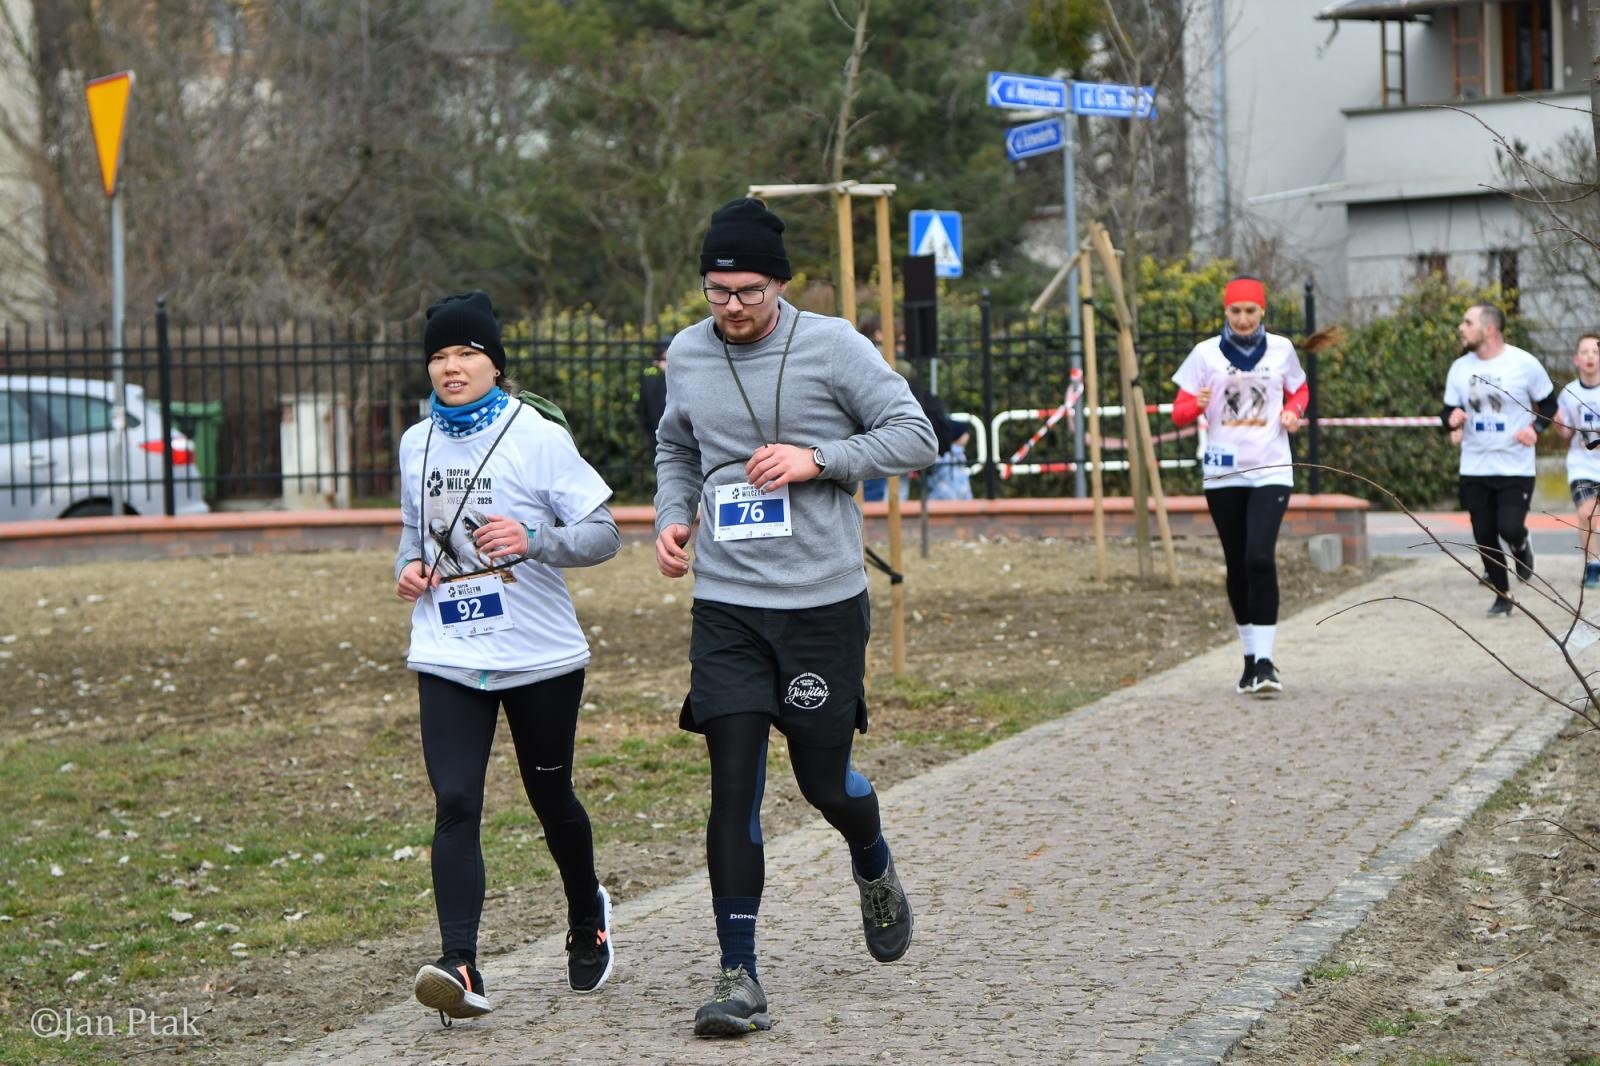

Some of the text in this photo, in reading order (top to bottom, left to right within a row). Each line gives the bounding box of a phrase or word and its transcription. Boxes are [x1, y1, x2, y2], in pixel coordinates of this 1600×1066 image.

[446, 468, 470, 477] TROPEM
[477, 497, 493, 505] 2026
[737, 501, 765, 523] 76
[457, 598, 484, 621] 92
